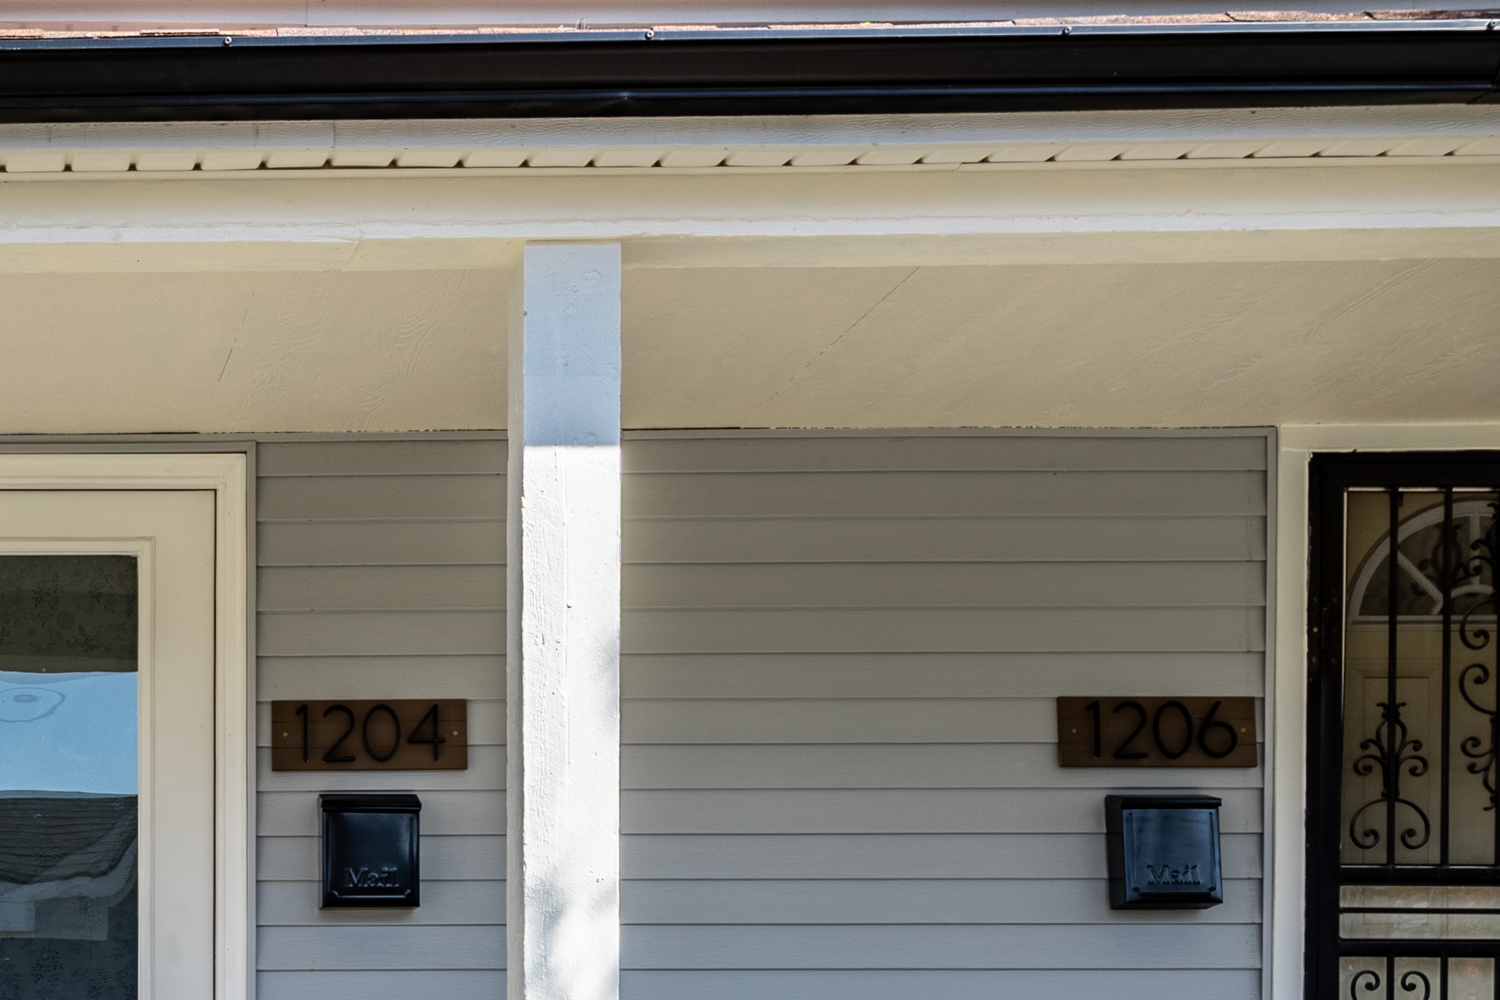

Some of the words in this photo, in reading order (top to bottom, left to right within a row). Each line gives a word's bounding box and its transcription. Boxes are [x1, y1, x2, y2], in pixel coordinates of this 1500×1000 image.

[296, 704, 446, 762] 1204
[1086, 700, 1238, 759] 1206
[344, 867, 400, 888] Mail
[1147, 864, 1202, 885] Mail
